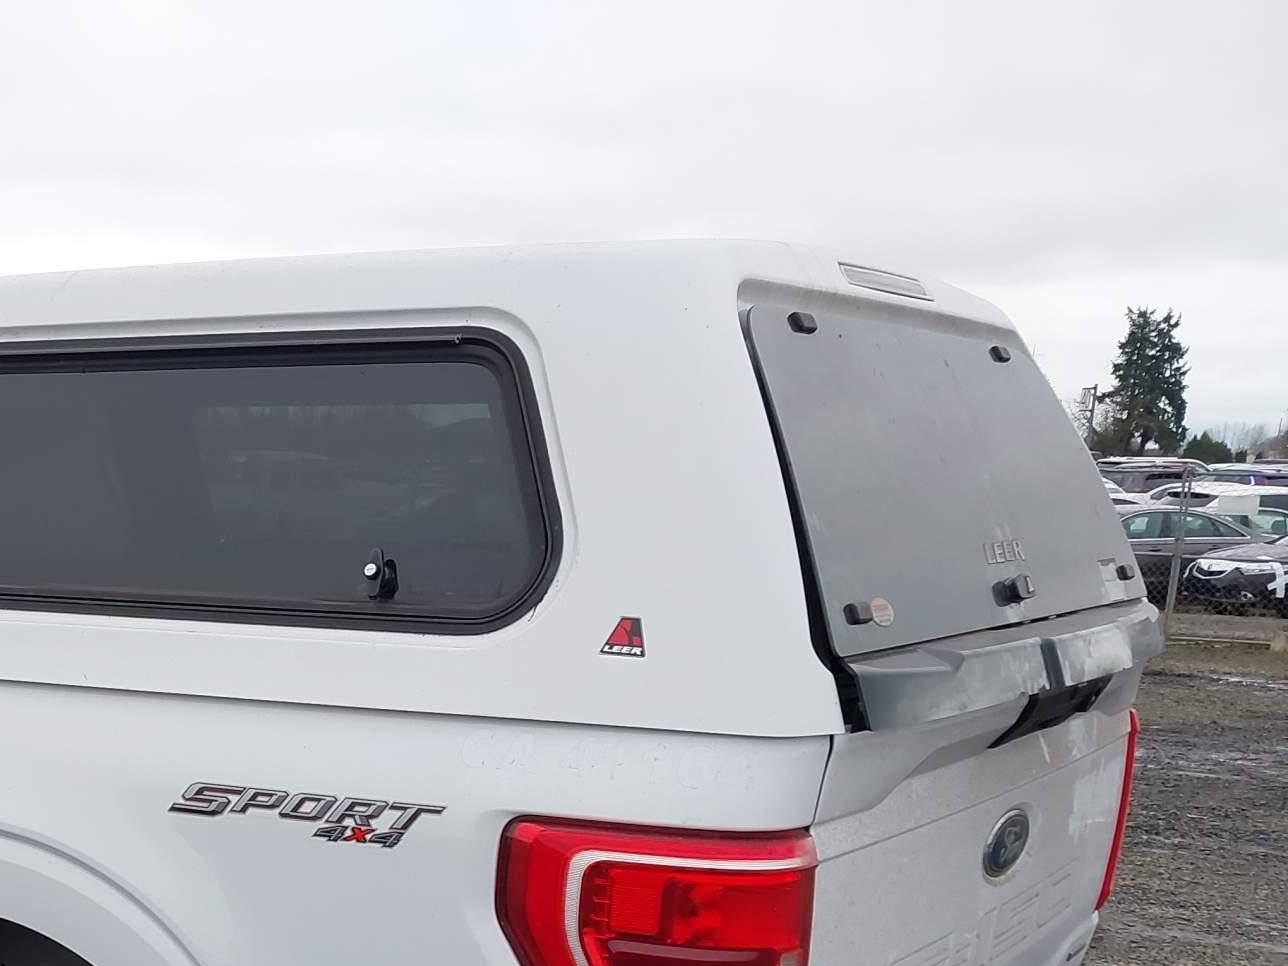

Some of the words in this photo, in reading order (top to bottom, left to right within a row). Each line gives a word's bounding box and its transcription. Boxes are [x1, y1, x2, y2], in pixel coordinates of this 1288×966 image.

[983, 540, 1025, 564] LEER
[602, 645, 643, 655] LEER
[168, 781, 448, 831] SPORT
